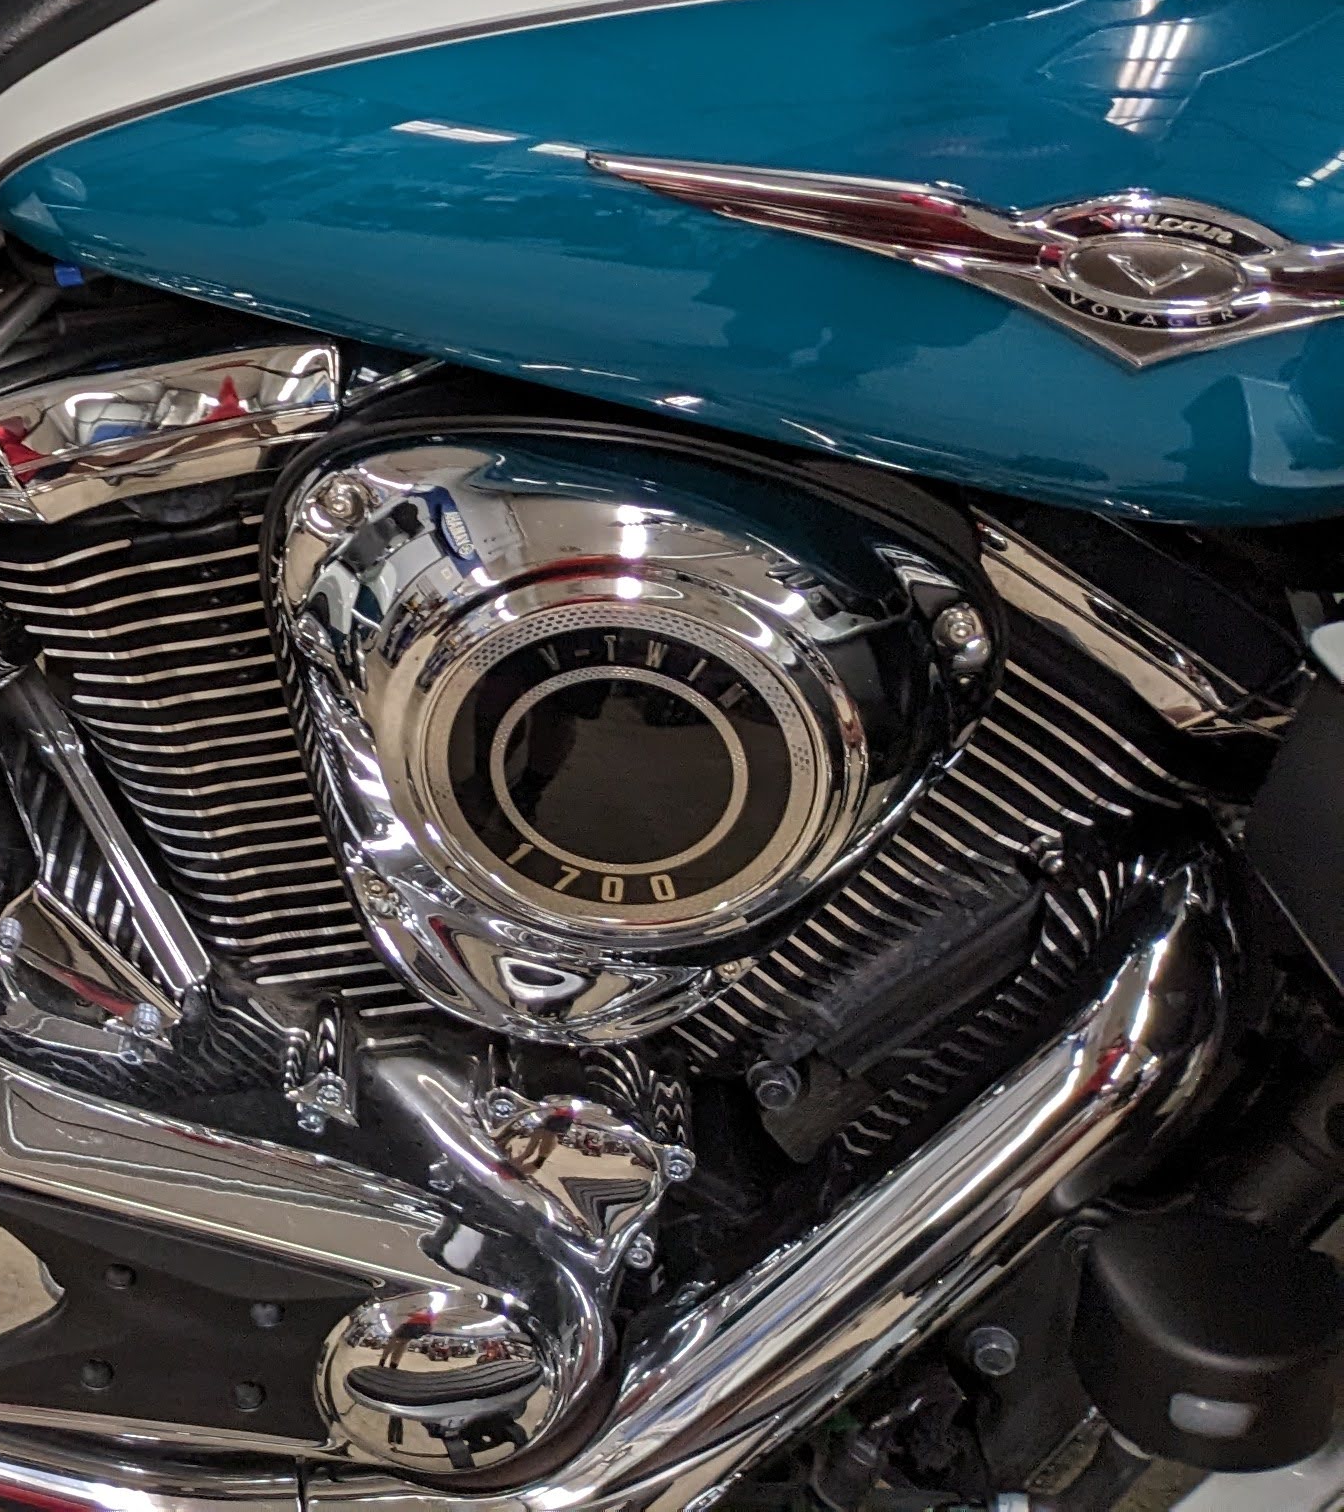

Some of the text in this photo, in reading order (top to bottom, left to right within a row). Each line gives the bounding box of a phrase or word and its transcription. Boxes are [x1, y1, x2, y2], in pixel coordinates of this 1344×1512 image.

[1089, 211, 1233, 245] Vulcan
[1069, 291, 1237, 327] VOYAGER
[538, 634, 749, 710] V-TWIN
[505, 843, 677, 903] 1700
